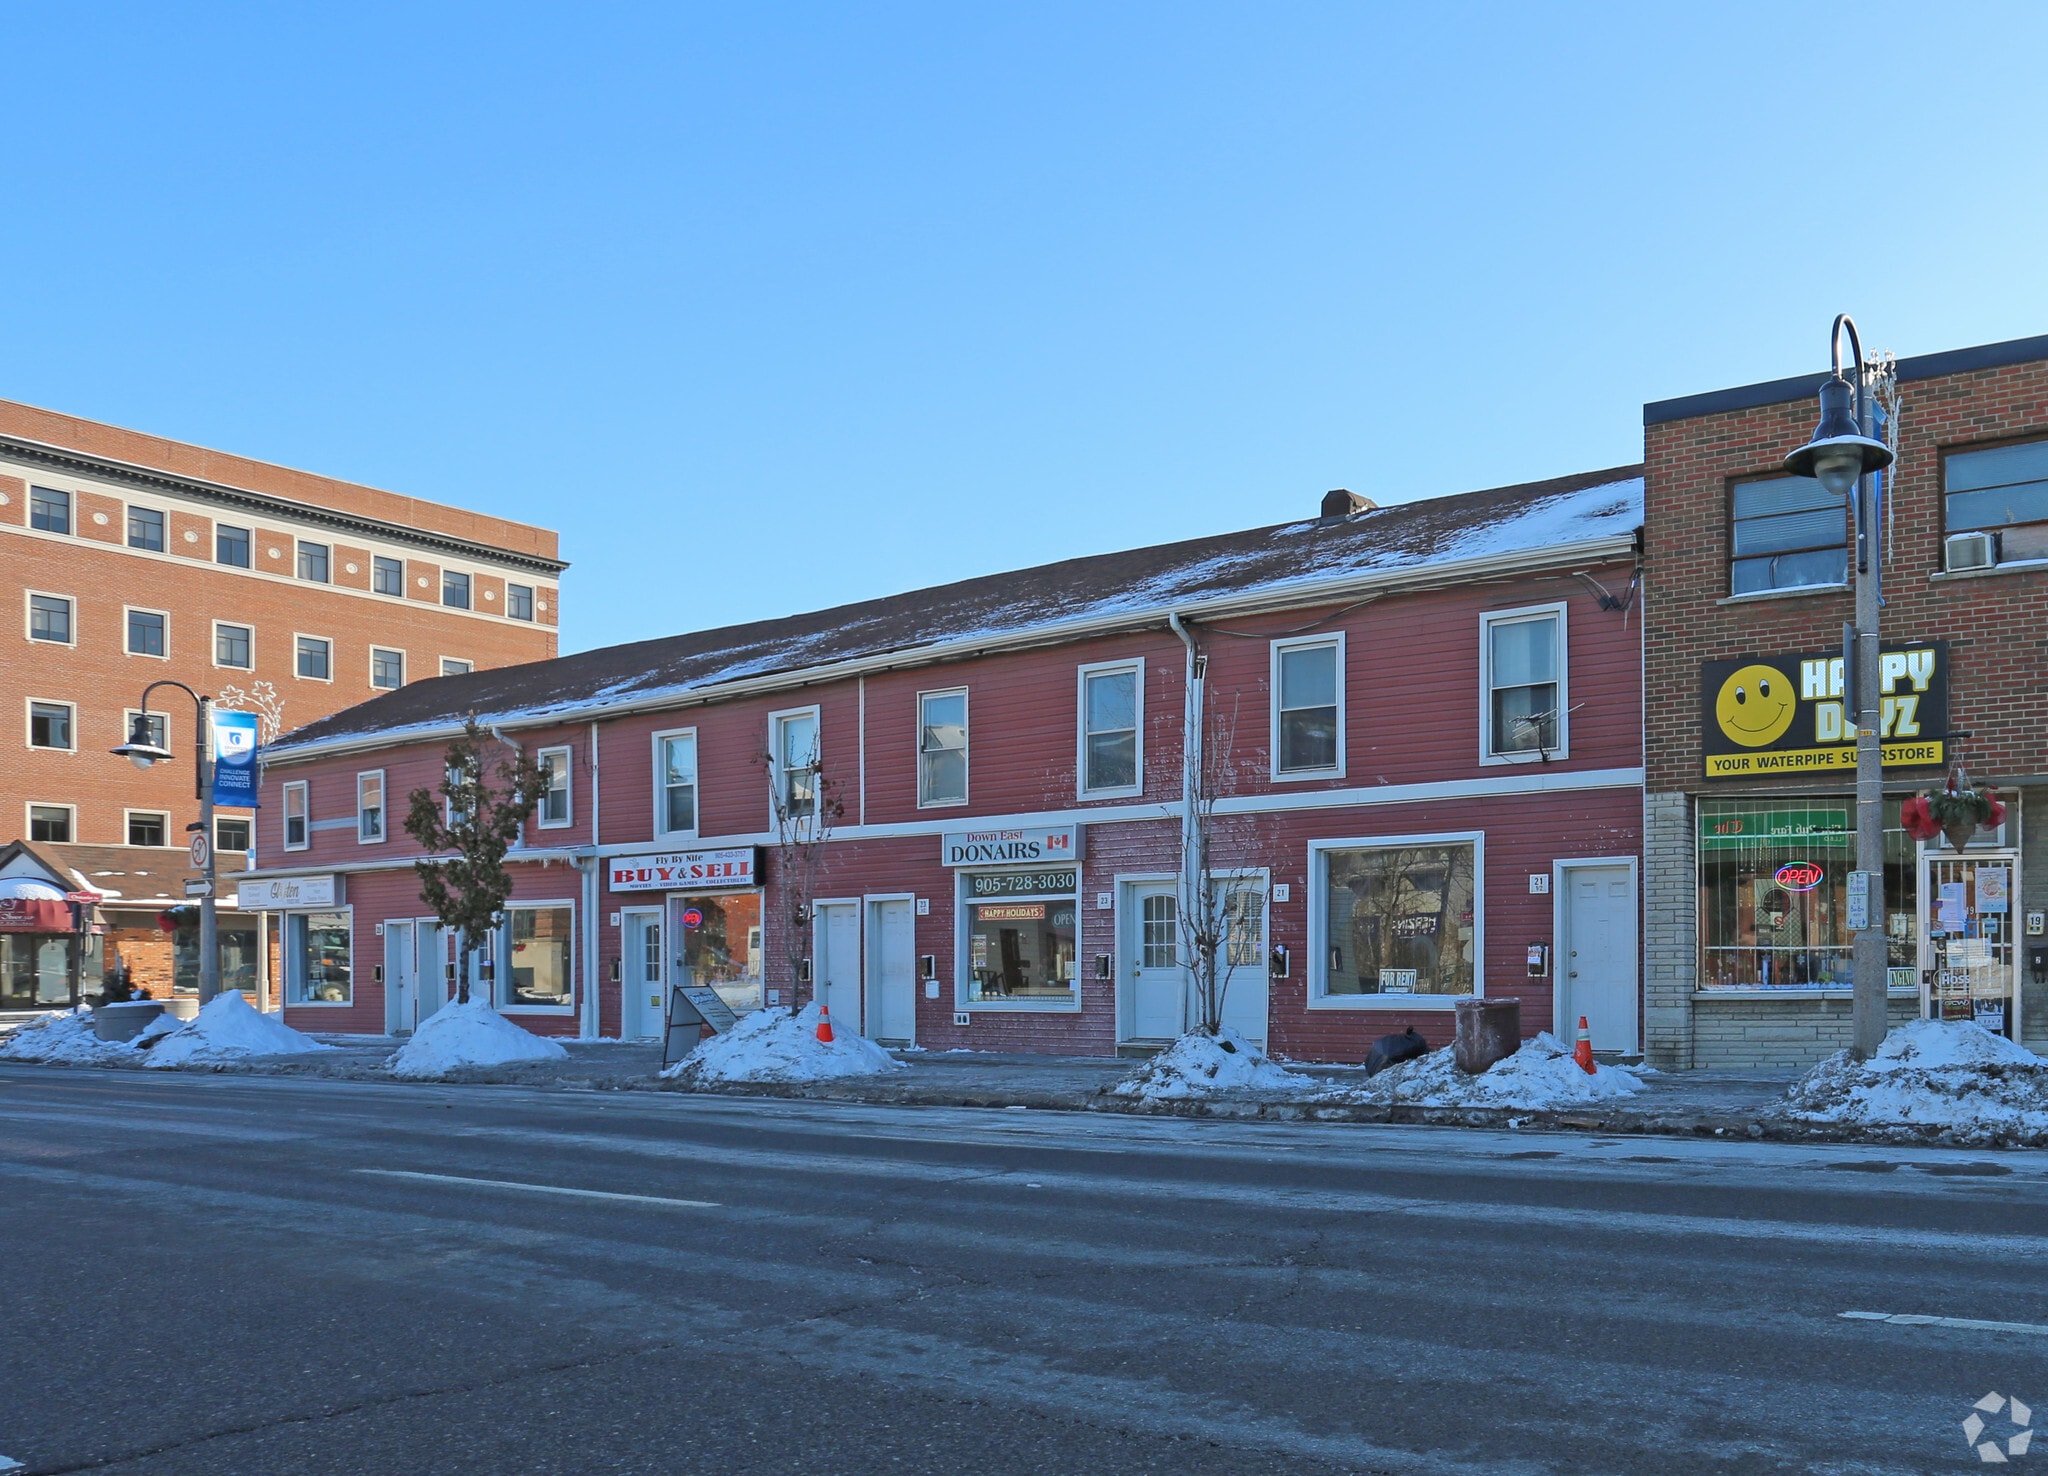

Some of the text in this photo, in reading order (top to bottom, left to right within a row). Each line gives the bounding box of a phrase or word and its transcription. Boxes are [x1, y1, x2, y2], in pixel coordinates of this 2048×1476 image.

[1801, 649, 1935, 700] HAPY
[1714, 747, 1935, 771] YOUR WATERPIPE SURSTORE
[218, 780, 251, 788] CONNECT
[219, 774, 251, 782] INNOVATE
[966, 830, 1023, 843] Down East
[951, 841, 1041, 863] DONAIRS
[656, 854, 704, 865] Fly By Nite
[613, 861, 754, 883] BUY & SELL
[1777, 869, 1819, 884] OPEN
[705, 877, 747, 885] COLLECTIBLES
[975, 873, 1075, 893] 905-728-3030
[1534, 877, 1544, 886] 21
[1276, 889, 1286, 897] 21
[1100, 897, 1109, 905] 23
[984, 907, 1040, 918] HAPPY HOLIDAYS
[1053, 912, 1077, 926] OPEN
[2030, 916, 2042, 926] 19
[1381, 971, 1415, 986] FOR RENT
